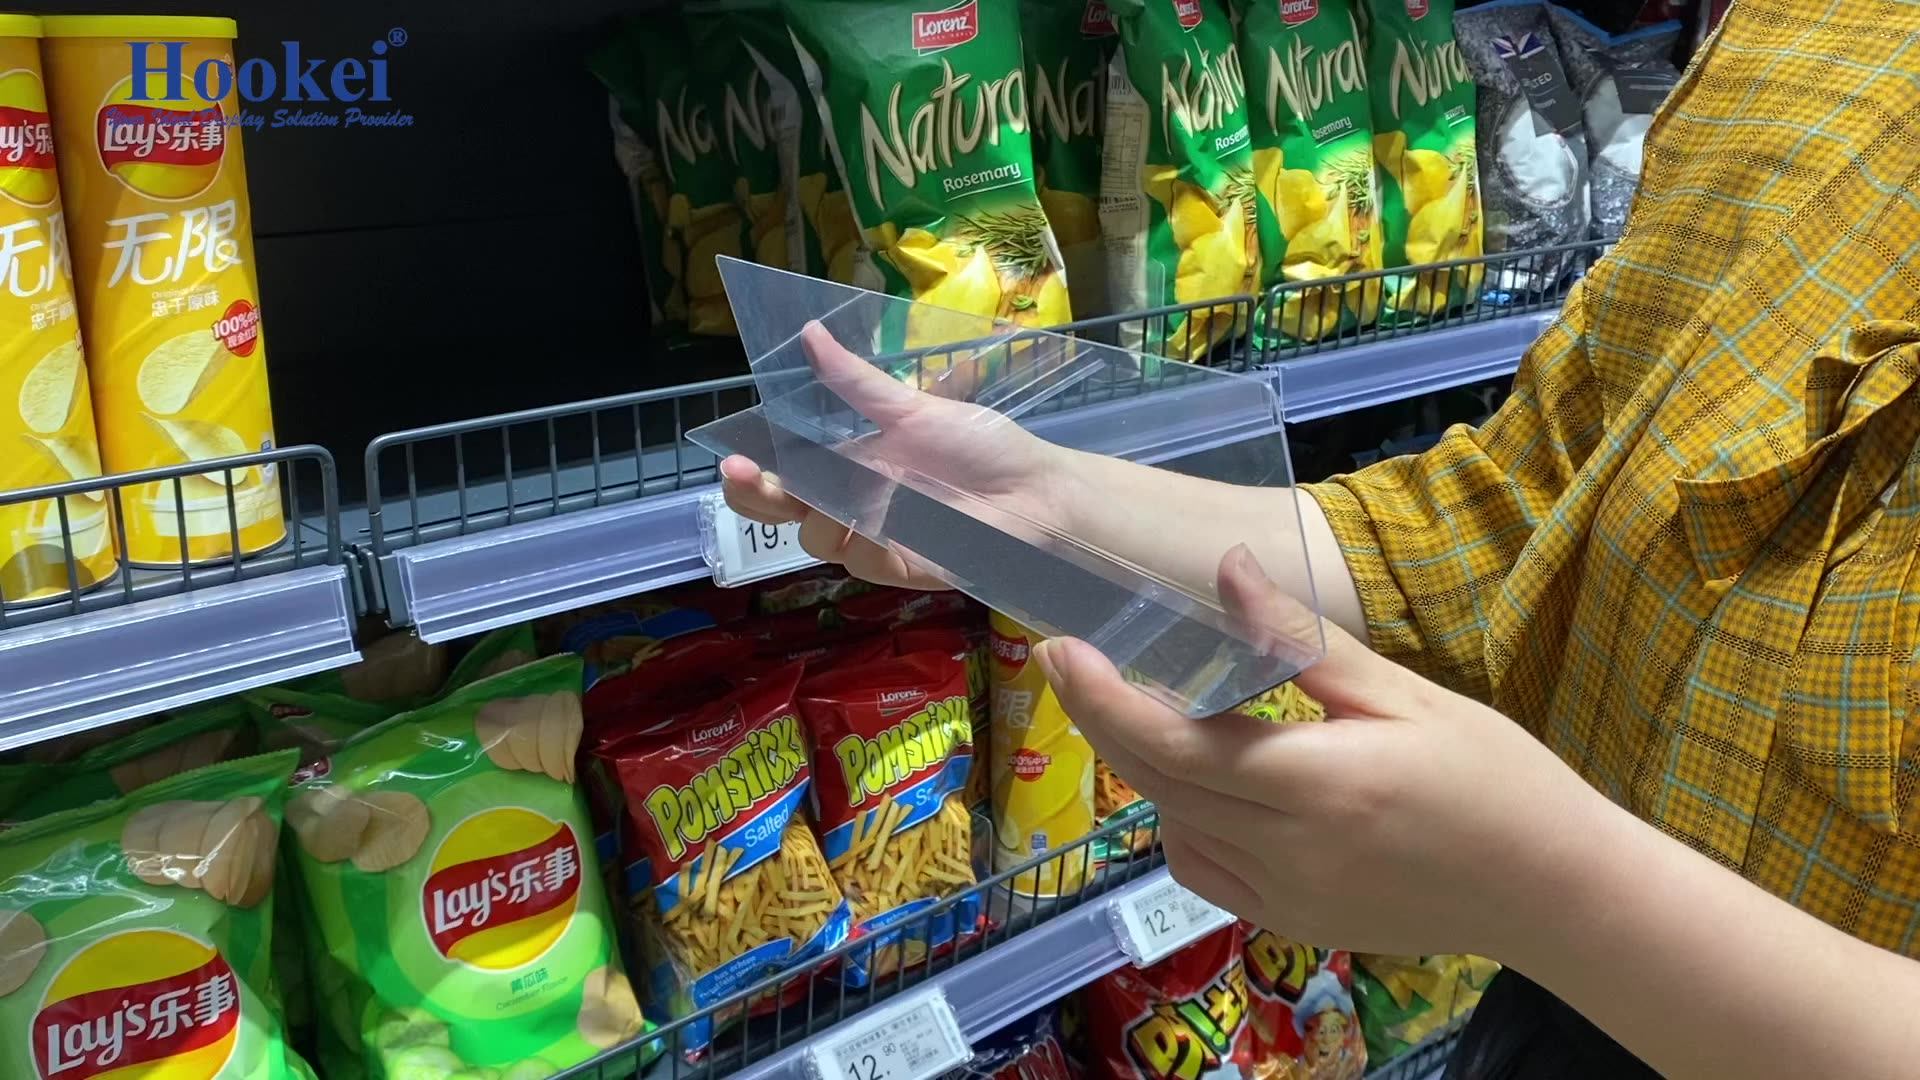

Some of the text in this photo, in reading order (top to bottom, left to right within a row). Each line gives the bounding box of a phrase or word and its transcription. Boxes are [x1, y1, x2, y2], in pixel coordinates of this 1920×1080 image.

[918, 16, 974, 38] Lorenz
[103, 117, 170, 157] Lay's
[943, 161, 1021, 193] Rosemary
[103, 200, 244, 288] 无限
[692, 716, 741, 743] Lorenz
[744, 803, 789, 848] Salted
[433, 845, 579, 934] Lay's 乐事
[46, 972, 235, 1074] Lay's 乐事
